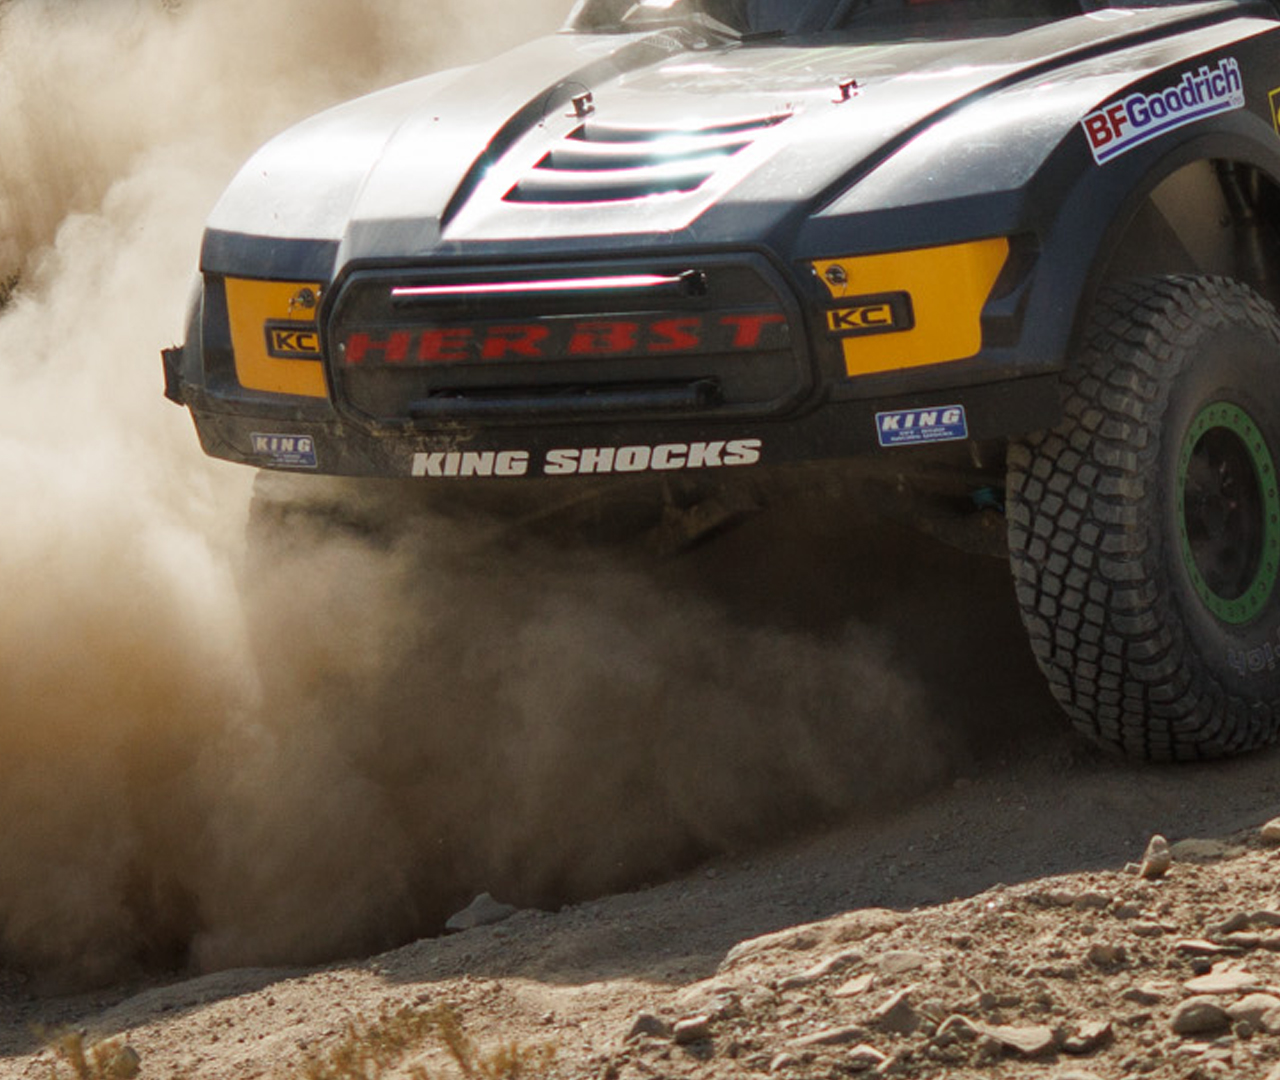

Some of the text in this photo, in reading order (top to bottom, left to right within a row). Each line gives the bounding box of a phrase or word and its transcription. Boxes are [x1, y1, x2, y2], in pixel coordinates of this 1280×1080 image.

[1083, 59, 1240, 150] BFGoodrich
[832, 307, 888, 329] KC
[276, 333, 316, 351] KC
[344, 314, 786, 364] HERBST
[882, 409, 961, 432] KING
[256, 438, 311, 452] KING
[412, 439, 763, 477] KING SHOCKS
